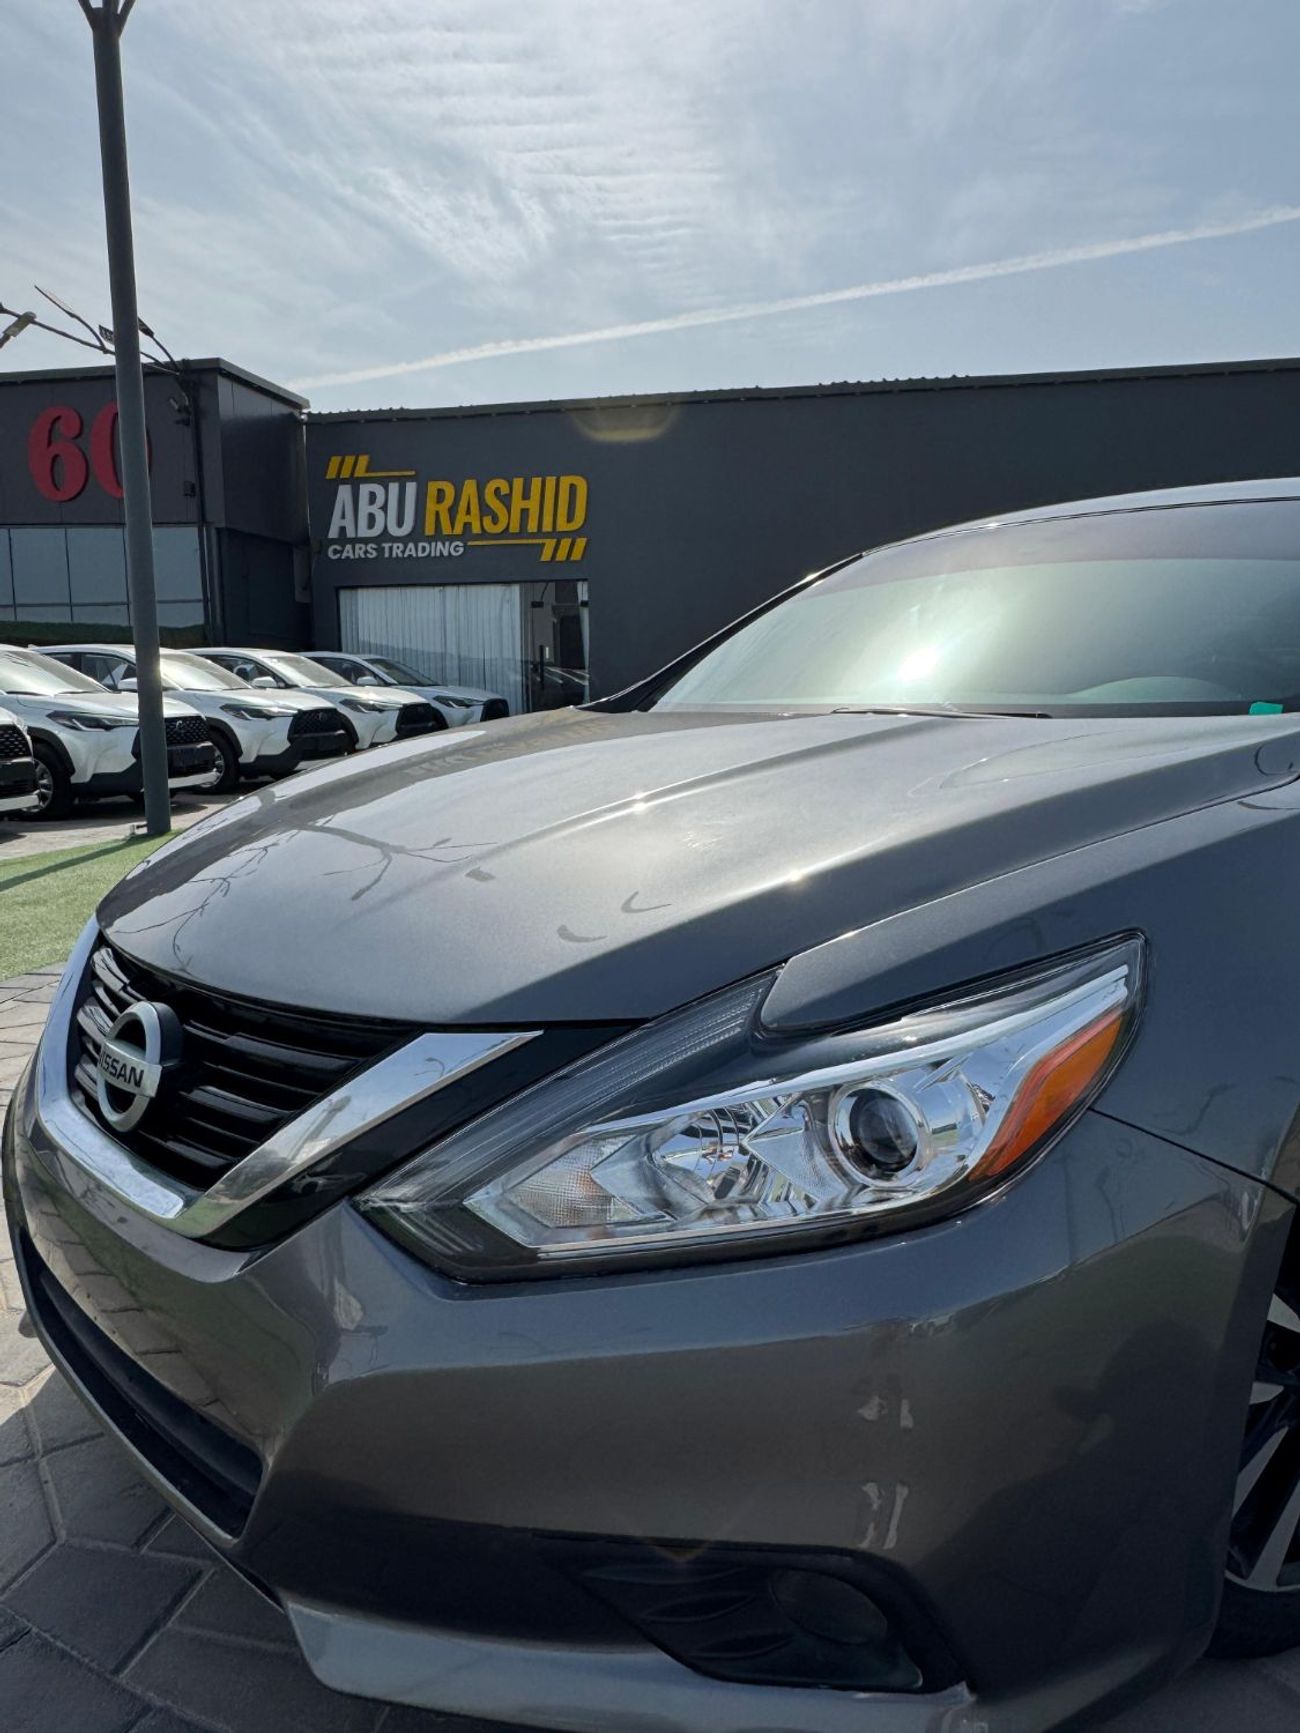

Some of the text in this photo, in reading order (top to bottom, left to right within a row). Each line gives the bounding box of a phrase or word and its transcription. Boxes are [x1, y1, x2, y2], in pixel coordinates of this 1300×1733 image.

[328, 475, 588, 538] ABU RASHID
[328, 541, 464, 559] CARS TRADING
